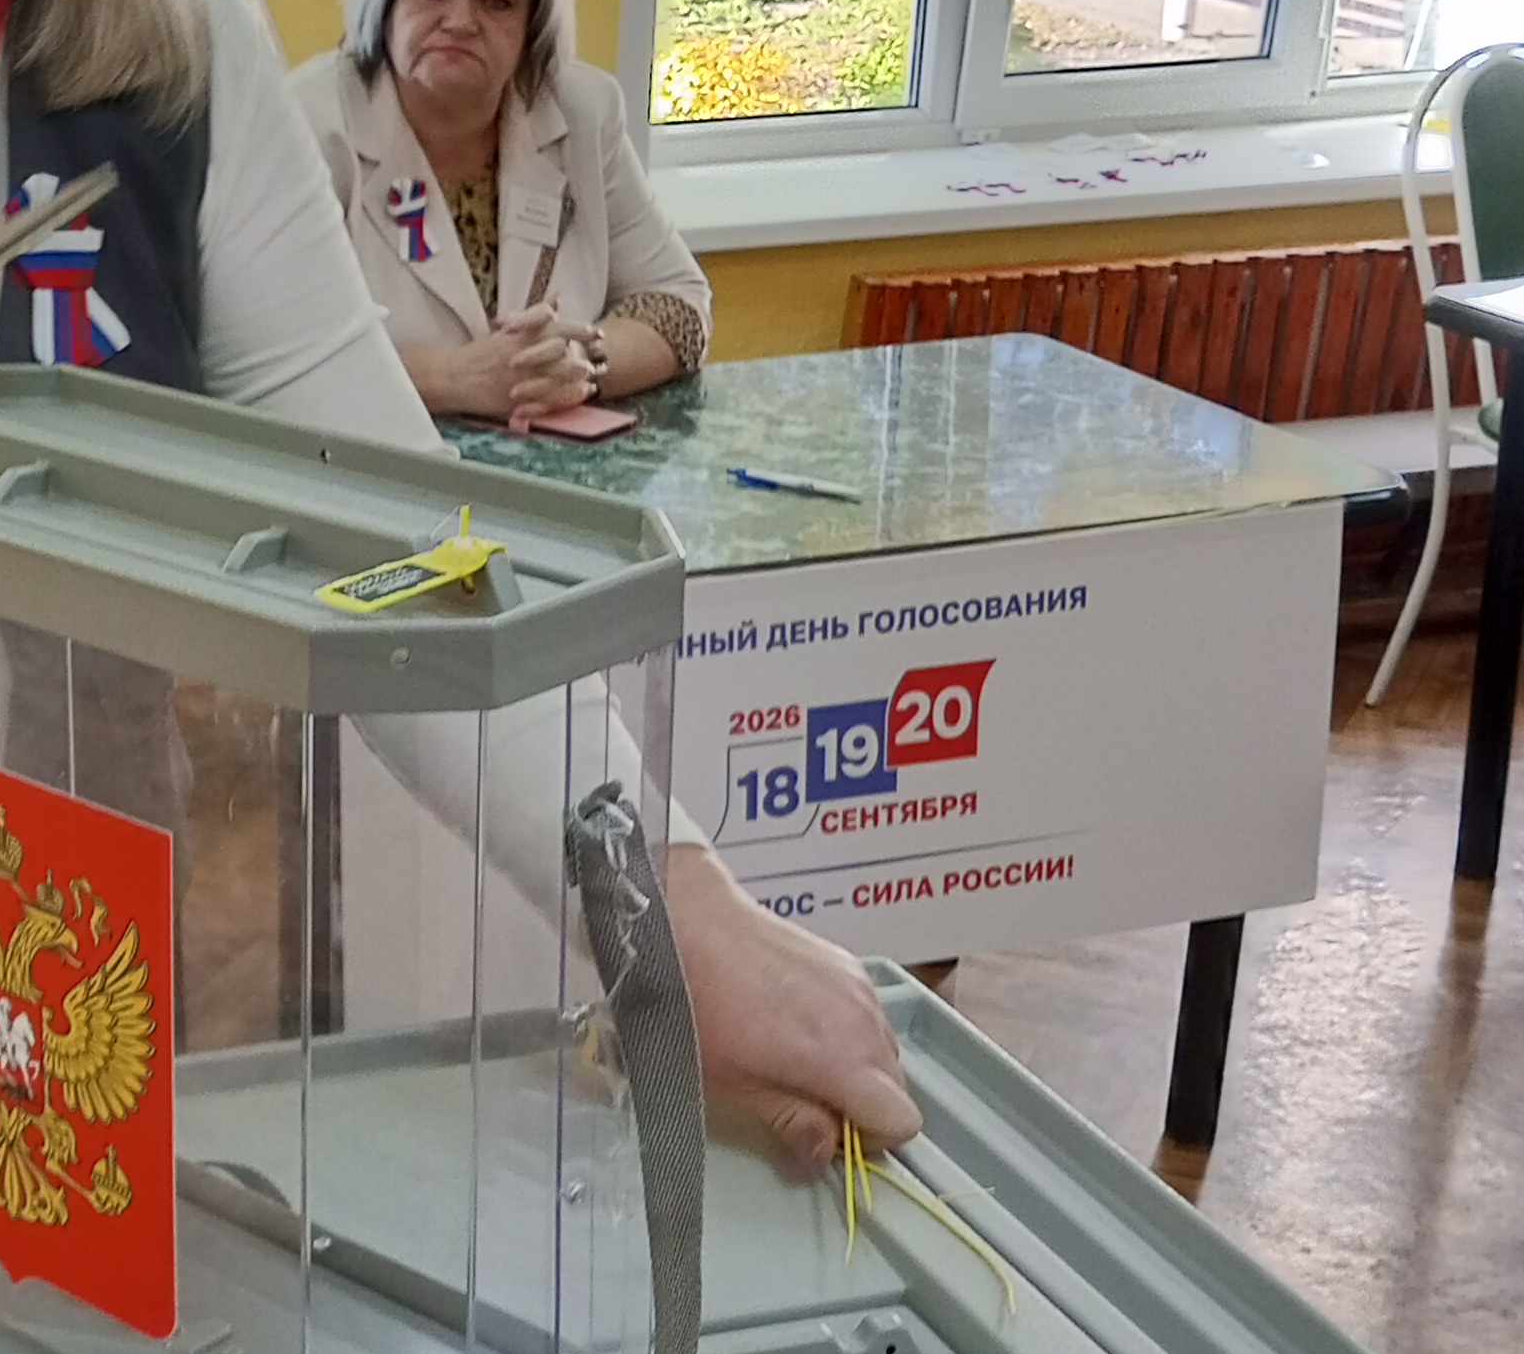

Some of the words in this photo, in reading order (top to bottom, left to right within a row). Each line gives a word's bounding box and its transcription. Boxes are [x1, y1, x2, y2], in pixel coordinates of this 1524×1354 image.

[766, 615, 850, 652] ДЕНЬ
[858, 585, 1088, 636] ГОЛОСОВАНИЯ
[728, 704, 801, 736] 2026
[737, 766, 800, 822] 18
[815, 724, 880, 783] 19
[894, 684, 974, 746] 20
[820, 791, 977, 835] СЕНТЯБРЯ
[852, 873, 935, 908] СИЛА
[943, 854, 1075, 895] РОССИИ!
